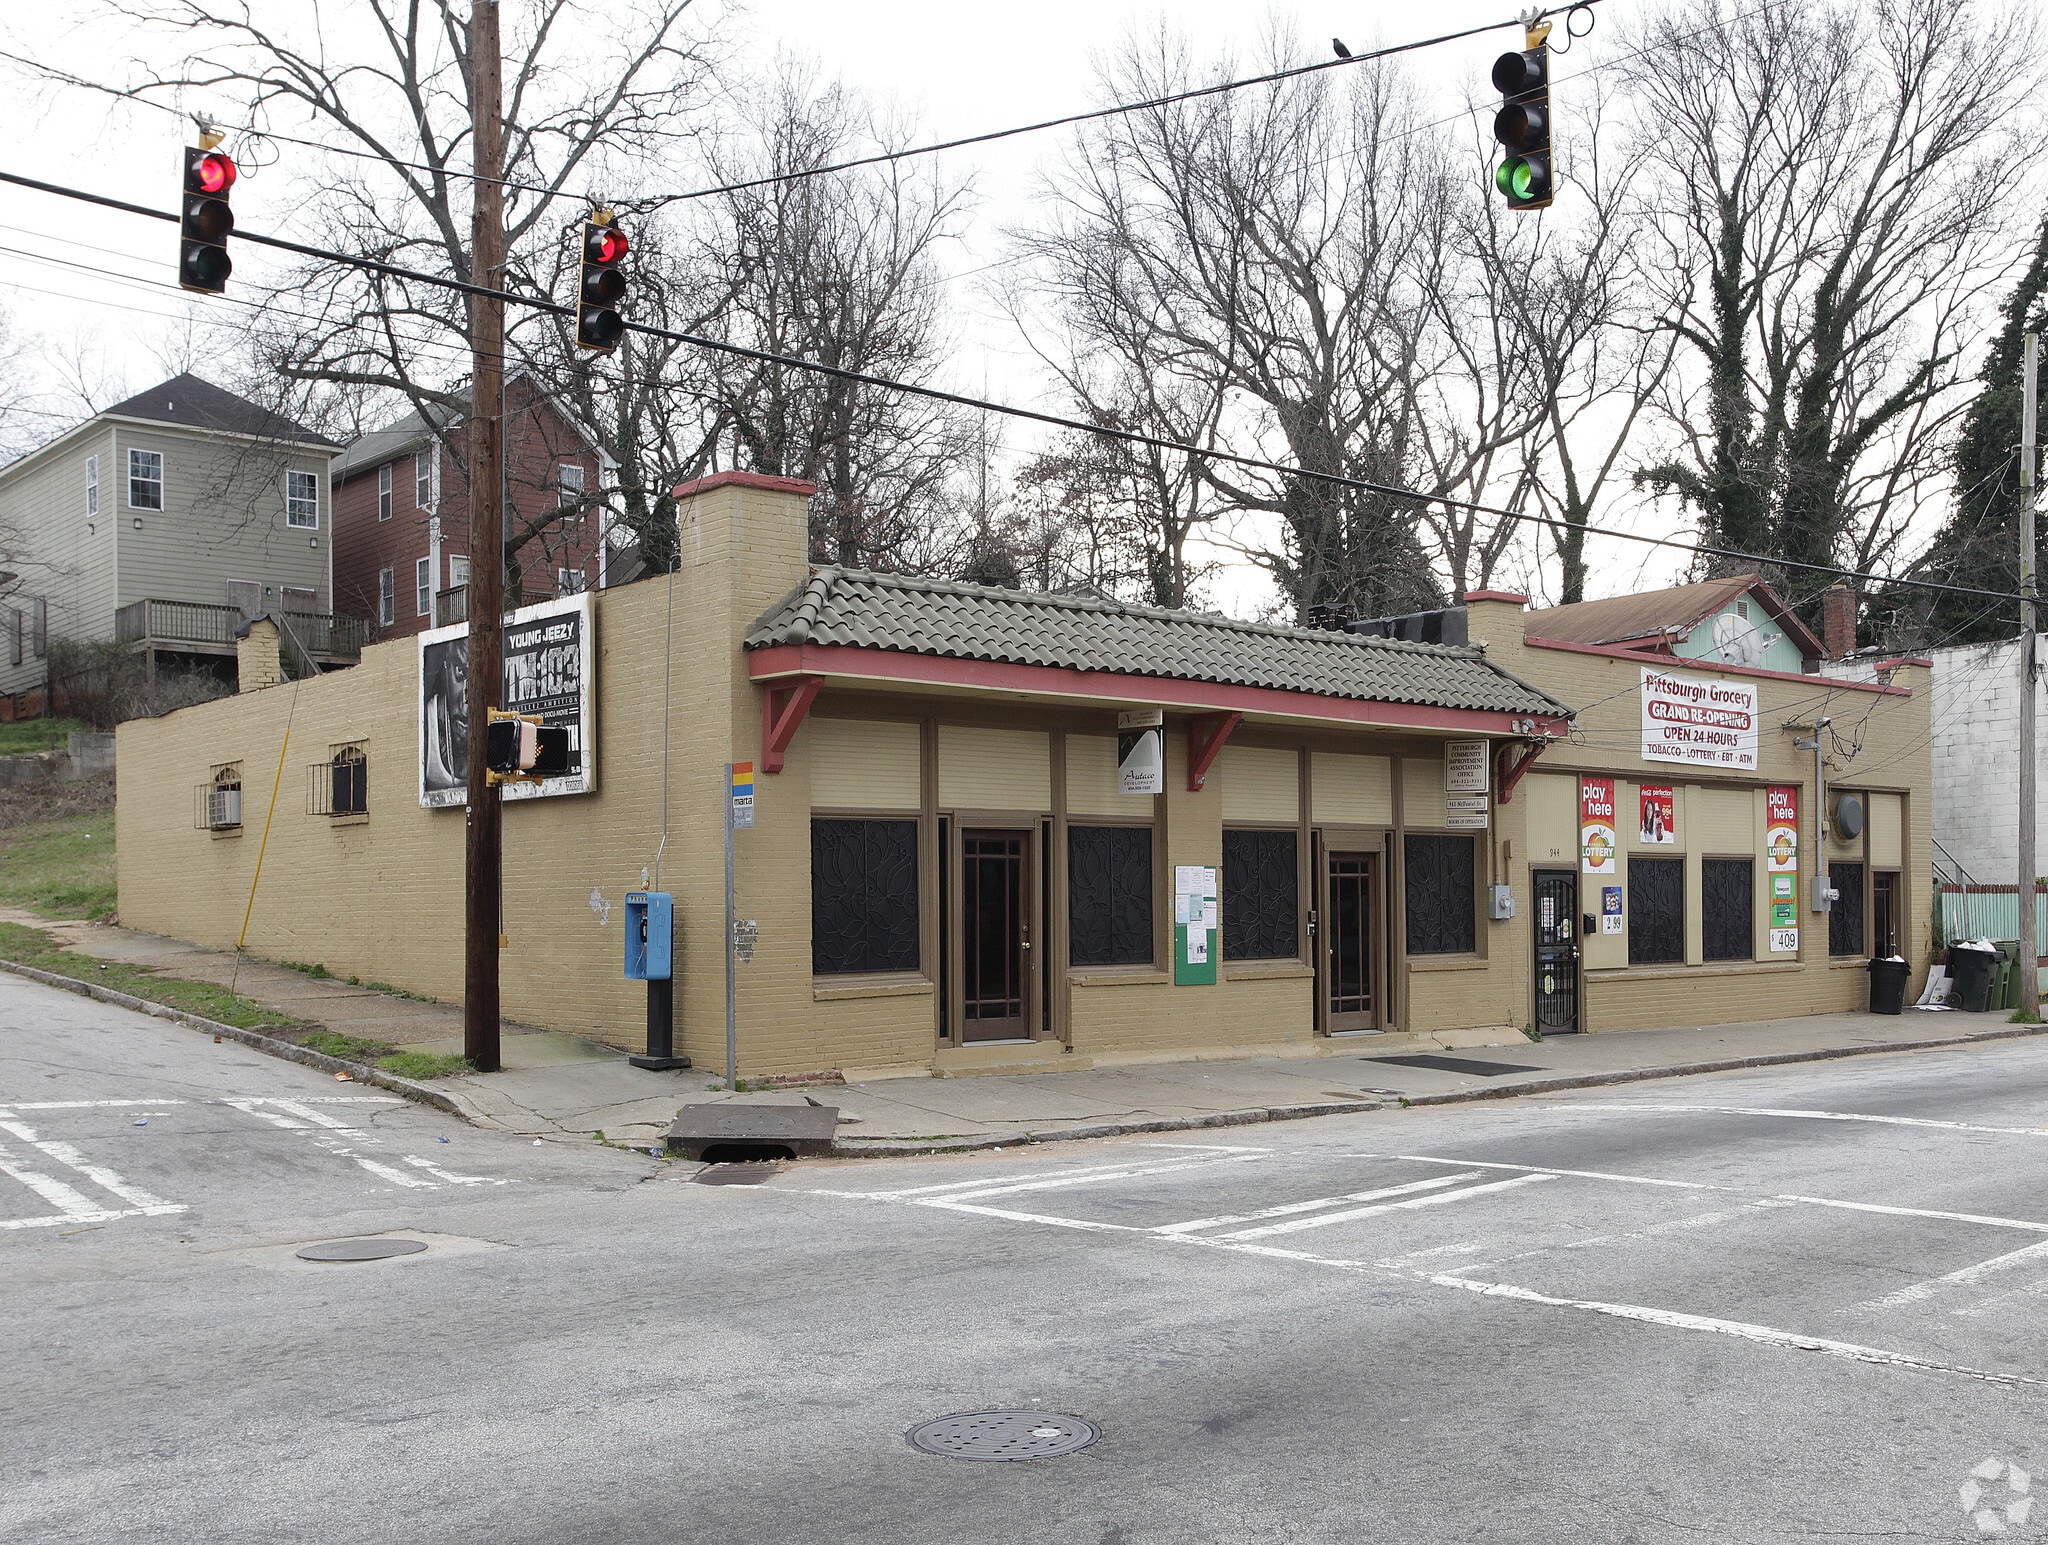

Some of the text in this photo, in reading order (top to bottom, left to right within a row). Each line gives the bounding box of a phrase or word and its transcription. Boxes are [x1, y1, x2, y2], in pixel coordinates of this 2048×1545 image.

[510, 622, 574, 649] YOUNG JEEZY
[1646, 675, 1751, 709] Pittsburgh Grocery
[1652, 702, 1748, 728] GRAND RE-OPENING
[1663, 726, 1738, 747] OPEN 24 HOURS
[1647, 744, 1753, 764] TOBACCO LOTTERY EBT ATM
[1583, 783, 1606, 802] play
[1769, 791, 1788, 807] play
[734, 797, 753, 805] marta
[1588, 800, 1612, 816] here
[1773, 805, 1794, 820] here
[1550, 848, 1560, 858] 944
[1582, 847, 1614, 858] LOTTERY
[1769, 847, 1796, 857] LOTTERY
